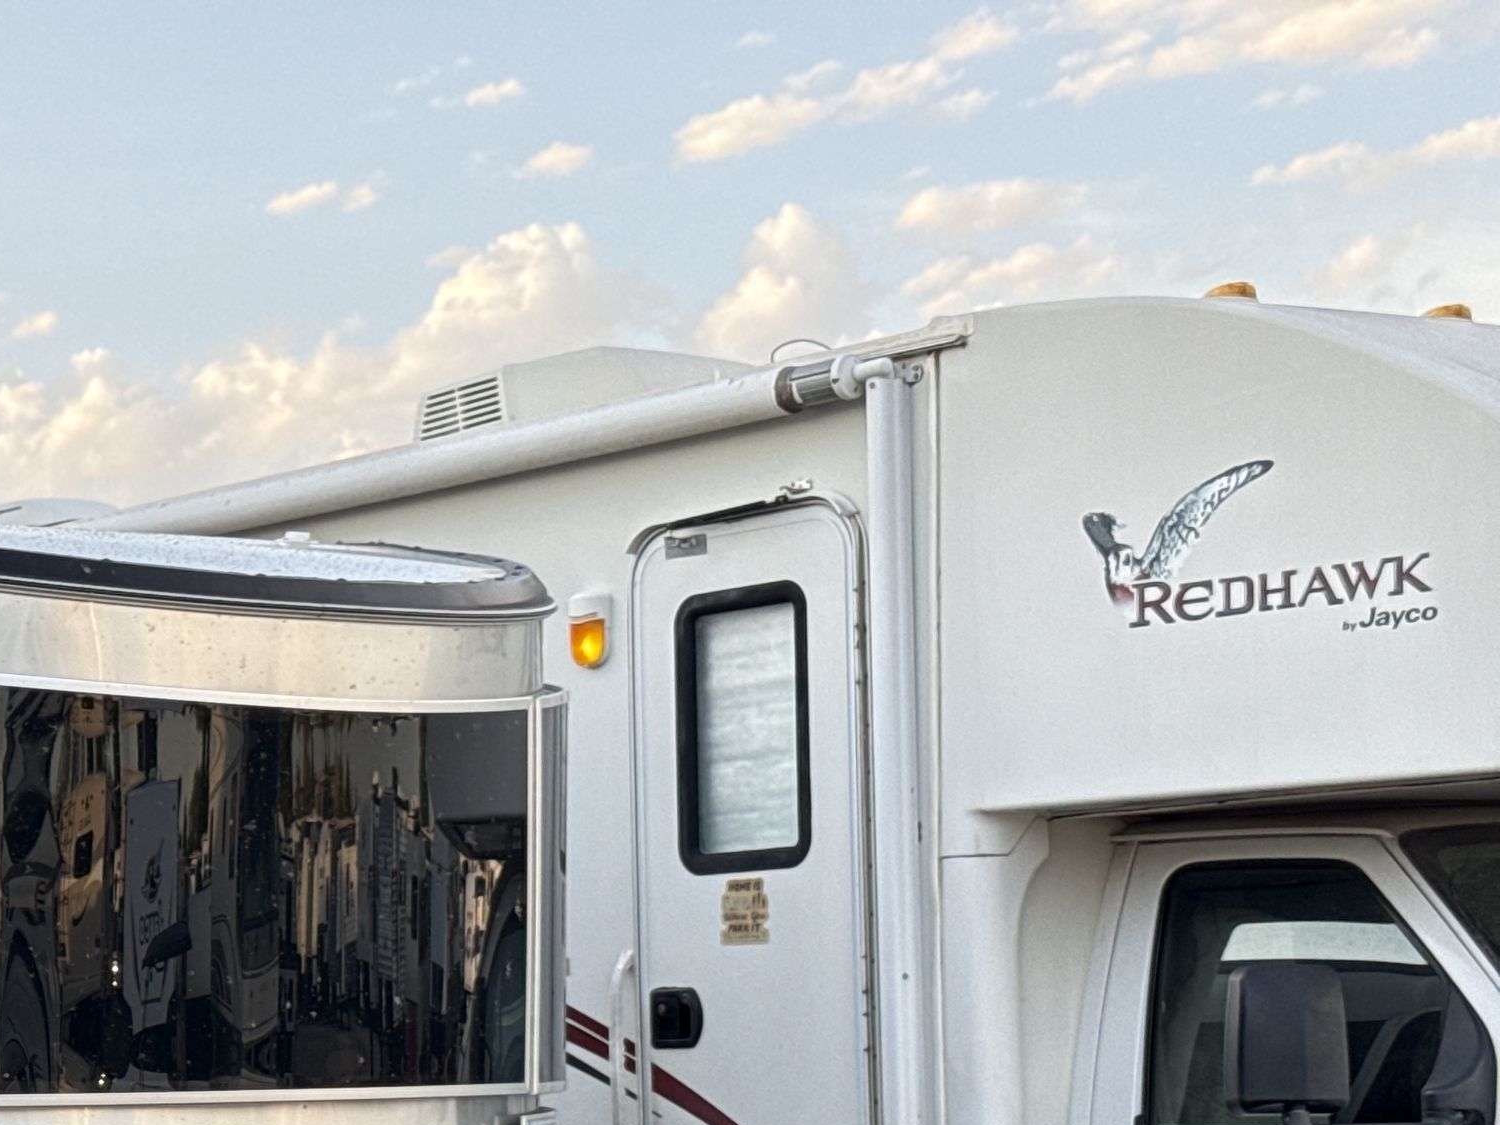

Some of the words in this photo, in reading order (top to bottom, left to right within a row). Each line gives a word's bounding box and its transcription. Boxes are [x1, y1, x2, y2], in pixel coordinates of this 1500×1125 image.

[1128, 552, 1433, 628] REDHAWK
[1342, 621, 1357, 632] by
[1359, 606, 1439, 630] Jayco
